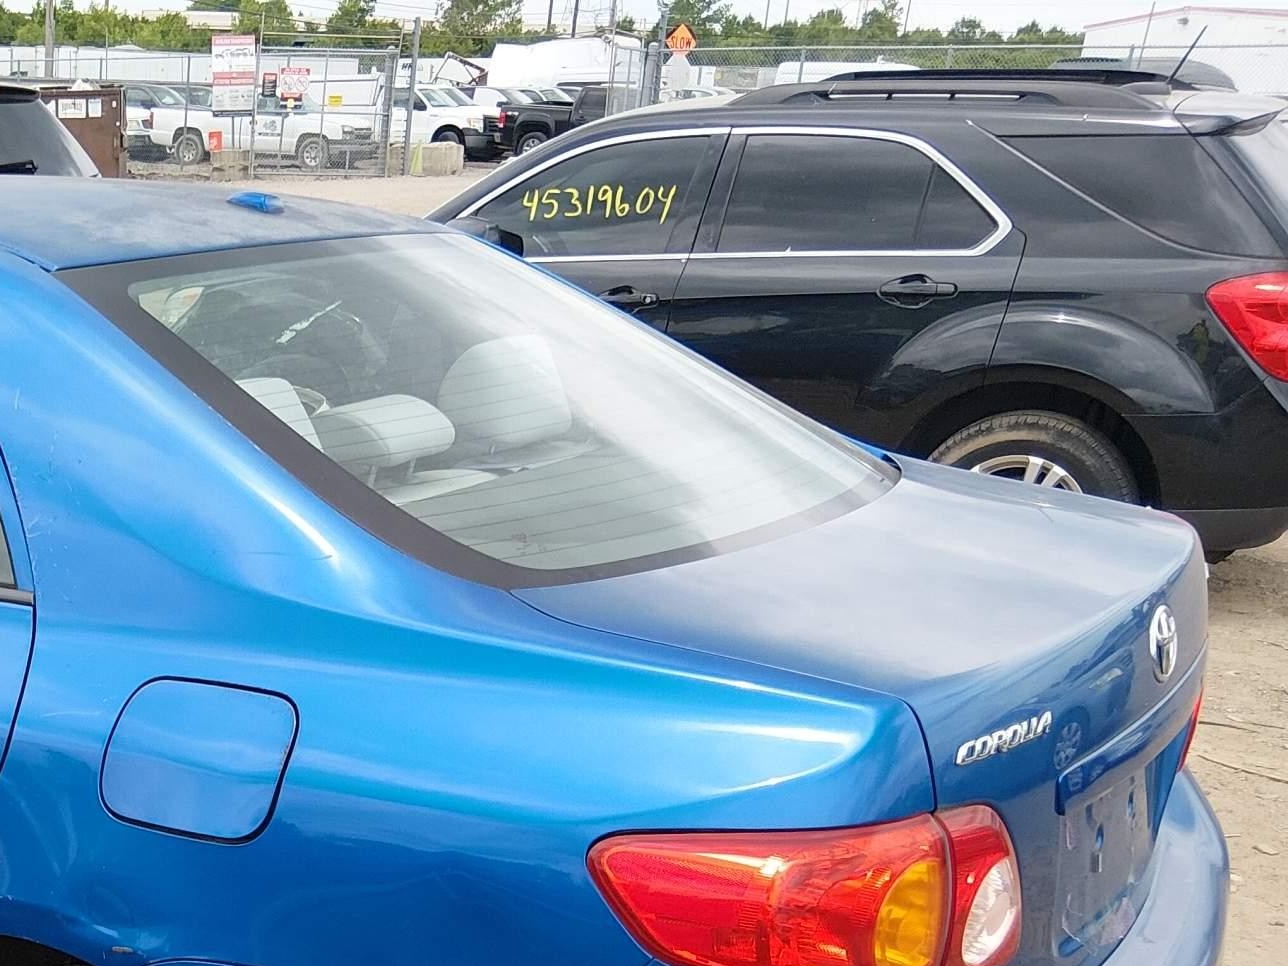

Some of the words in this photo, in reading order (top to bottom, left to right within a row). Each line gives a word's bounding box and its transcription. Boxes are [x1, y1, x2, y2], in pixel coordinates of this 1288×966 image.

[670, 35, 692, 49] SLOW
[522, 184, 677, 225] 45319604
[954, 710, 1053, 766] COROLLA
